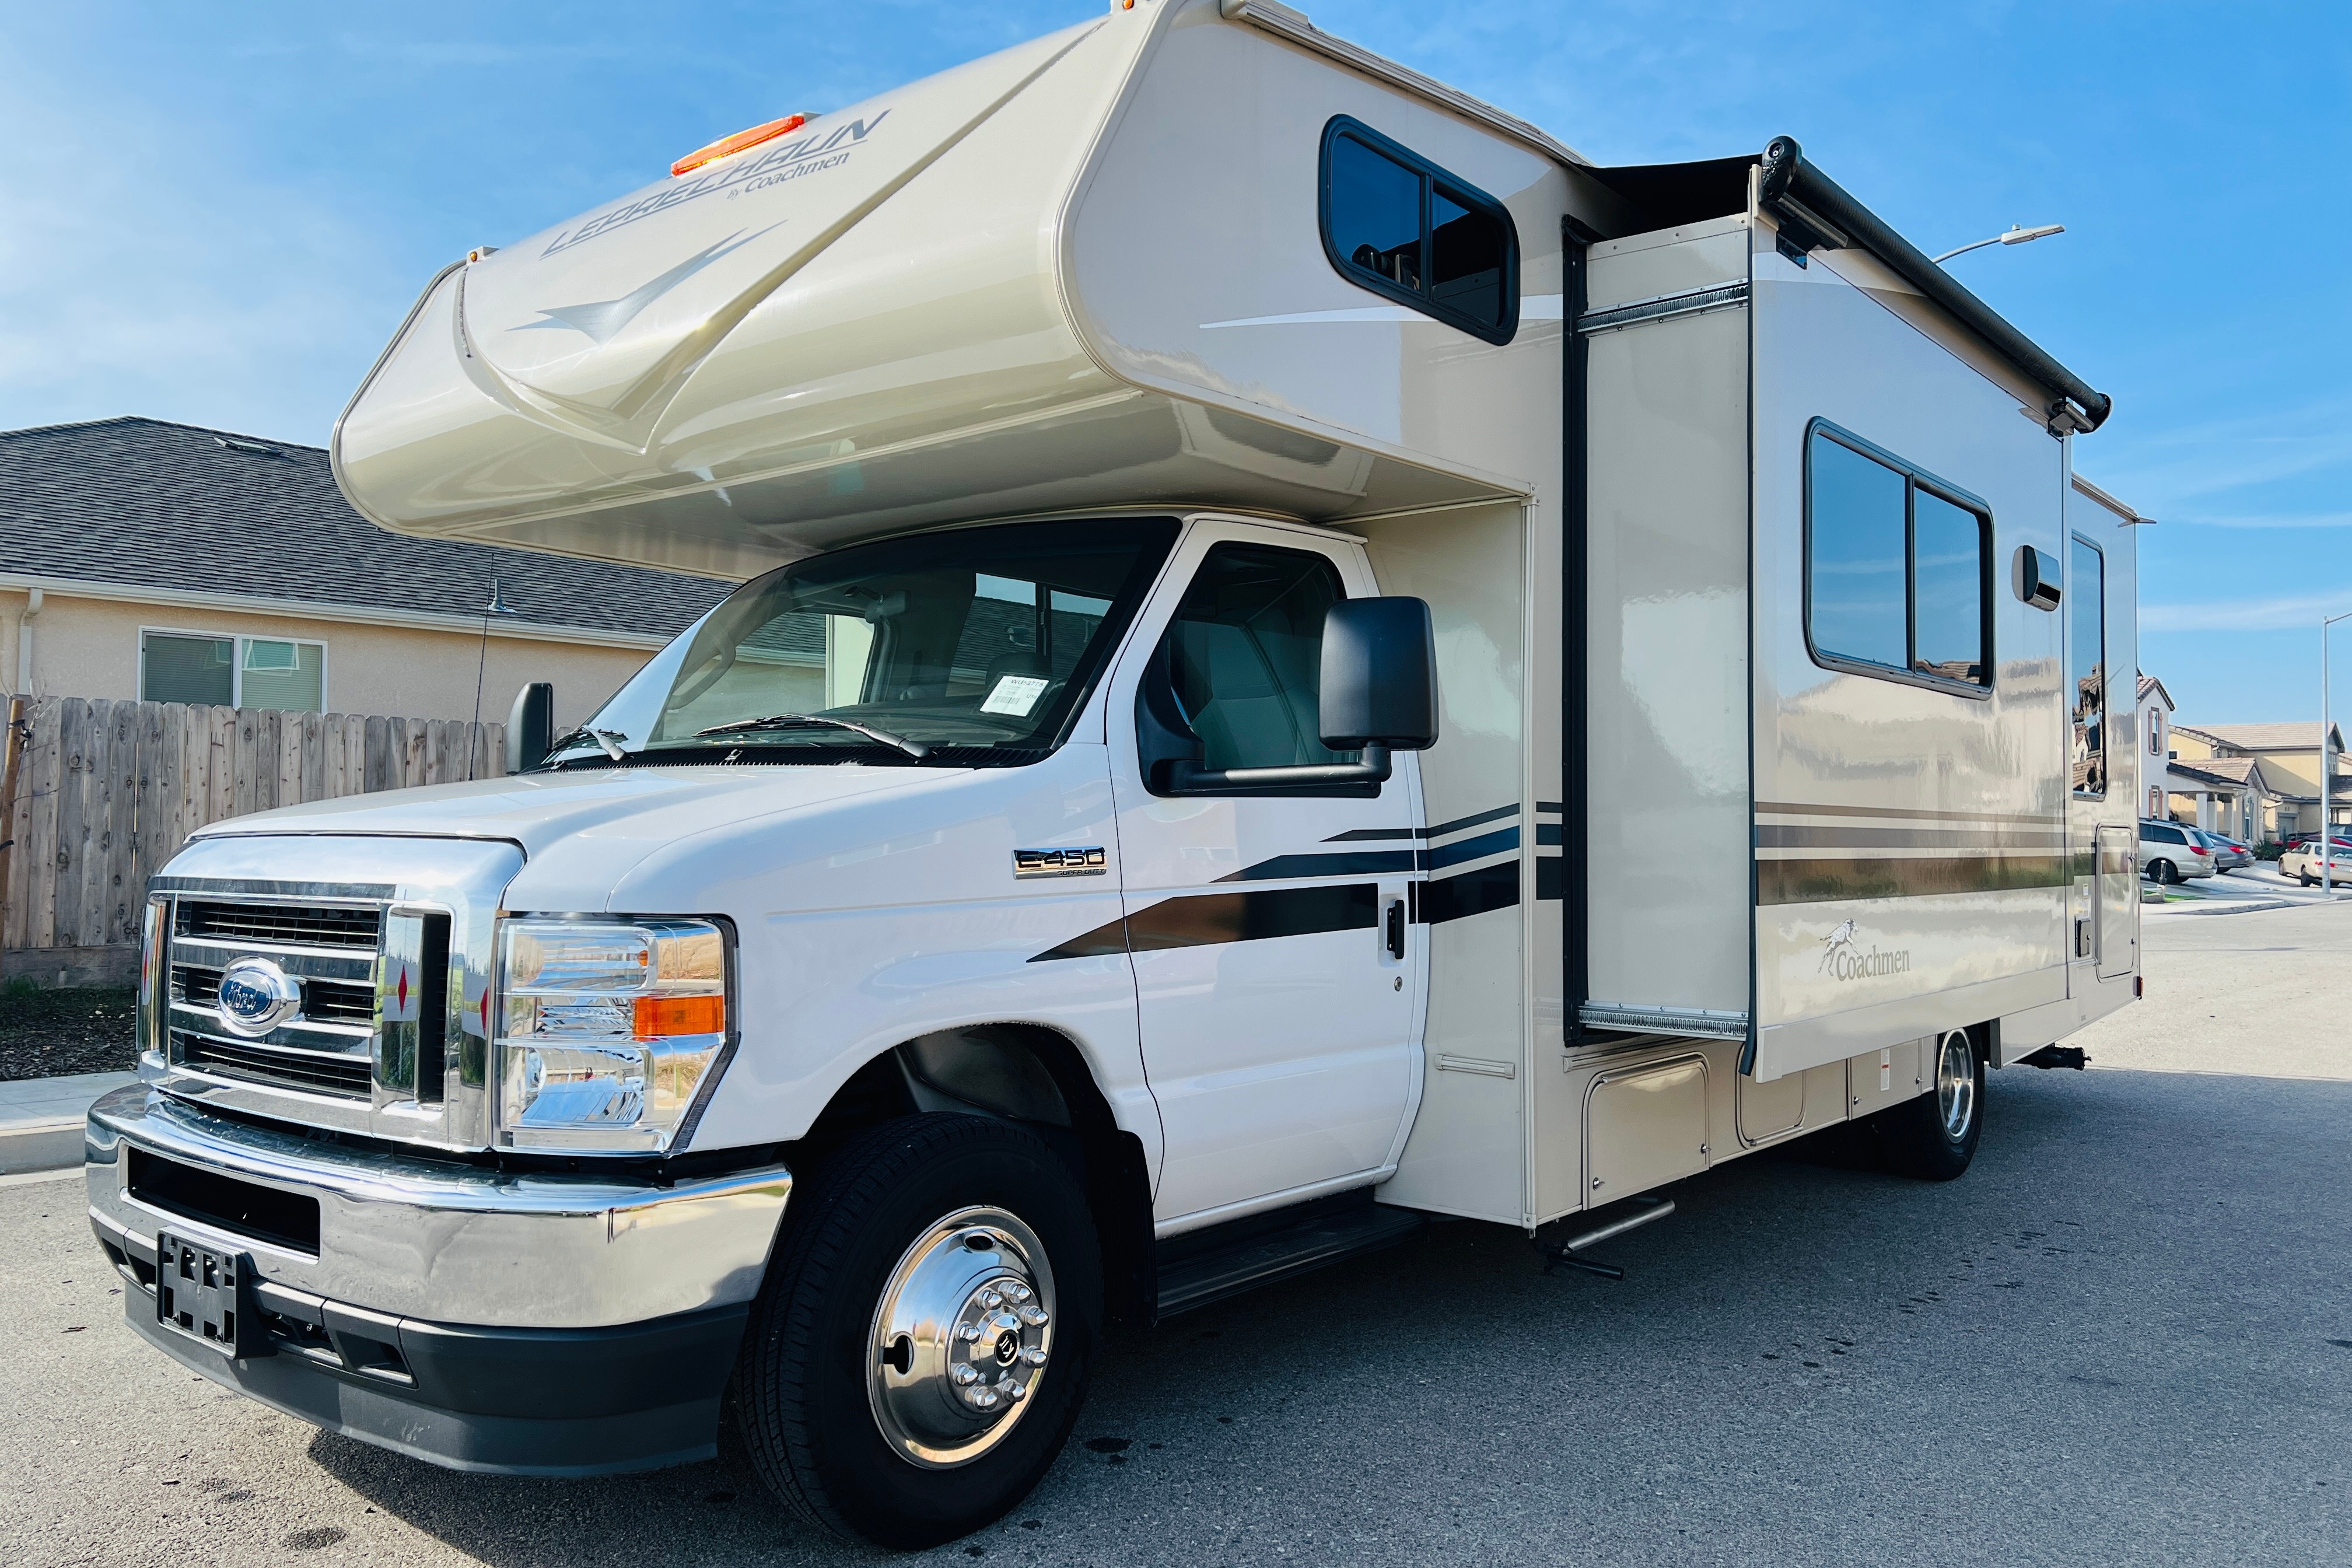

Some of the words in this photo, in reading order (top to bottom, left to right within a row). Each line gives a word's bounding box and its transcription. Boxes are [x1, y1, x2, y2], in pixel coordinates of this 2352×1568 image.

[540, 108, 892, 257] LEPRECHAUN
[744, 152, 850, 193] Coachmen
[1836, 944, 1910, 982] Coachmen
